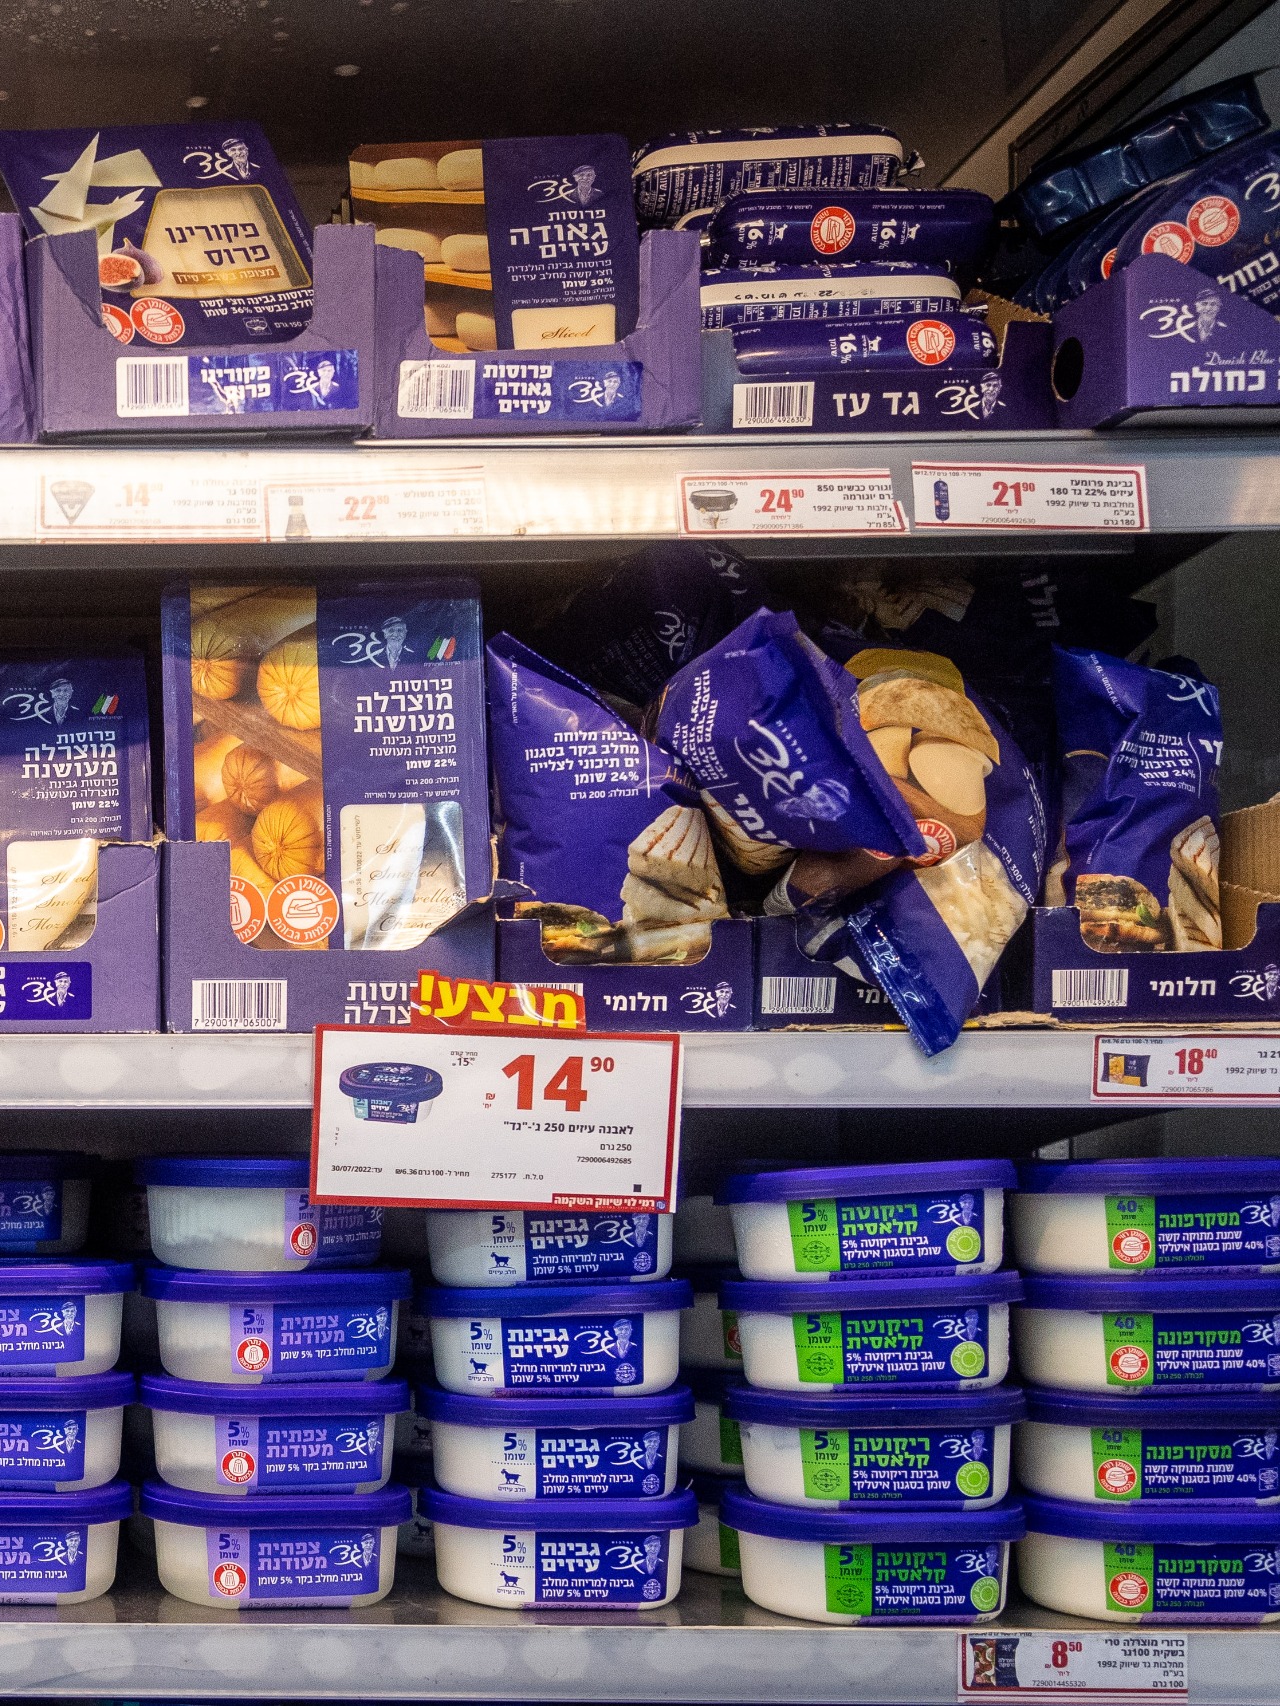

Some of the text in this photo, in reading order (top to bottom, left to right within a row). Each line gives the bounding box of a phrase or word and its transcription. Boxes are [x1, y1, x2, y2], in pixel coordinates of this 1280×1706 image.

[548, 210, 605, 221] פרוסות
[165, 220, 260, 245] פקורינו
[510, 222, 608, 245] גאודה
[204, 243, 270, 267] פרוס
[539, 241, 608, 258] עיזים
[548, 262, 573, 270] גבינה
[562, 280, 587, 289] שומן
[1171, 368, 1266, 393] כחולה
[1070, 479, 1133, 488] גבינת פרומעז
[992, 481, 1035, 507] 21 90
[1071, 488, 1081, 496] גד
[1110, 489, 1134, 497] עיזים
[760, 489, 804, 513] 24 90
[390, 679, 453, 692] פרוסות
[357, 692, 453, 713] מוצרלה
[354, 713, 456, 733] מעושנת
[382, 733, 456, 746] פרוסות גבינת
[554, 731, 638, 742] גבינה מלוחה
[370, 744, 457, 757] מוצרלה מעושנת
[525, 743, 639, 760] מחלב בקר בסגנון
[406, 758, 457, 770] 22% שומן
[530, 757, 639, 773] ים תיכוני לצלייה
[575, 771, 639, 785] 24% שומן
[570, 791, 587, 799] גרם
[298, 878, 327, 896] שומן
[272, 916, 301, 941] גבוהה
[419, 974, 579, 1030] מבצע!
[603, 994, 668, 1012] חלומי
[1175, 1048, 1218, 1075] 18 40
[501, 1054, 615, 1112] 14 90
[544, 1122, 634, 1135] לאבנה עיזים 250
[600, 1143, 632, 1151] 250 גרם
[554, 1195, 655, 1208] רמי לוי שיווק השקמה
[841, 1203, 918, 1222] ריקוטה
[842, 1219, 918, 1237] קלאסית
[267, 1429, 327, 1443] צפתית
[267, 1444, 334, 1459] מעודנת
[1146, 1445, 1233, 1462] מסקרפונה
[541, 1542, 600, 1556] גבינת
[541, 1558, 600, 1573] עיזים
[1123, 1639, 1158, 1647] מוצרלה
[1162, 1639, 1185, 1647] כדורי
[1052, 1640, 1083, 1669] 8 50
[1153, 1649, 1185, 1658] בשקית
